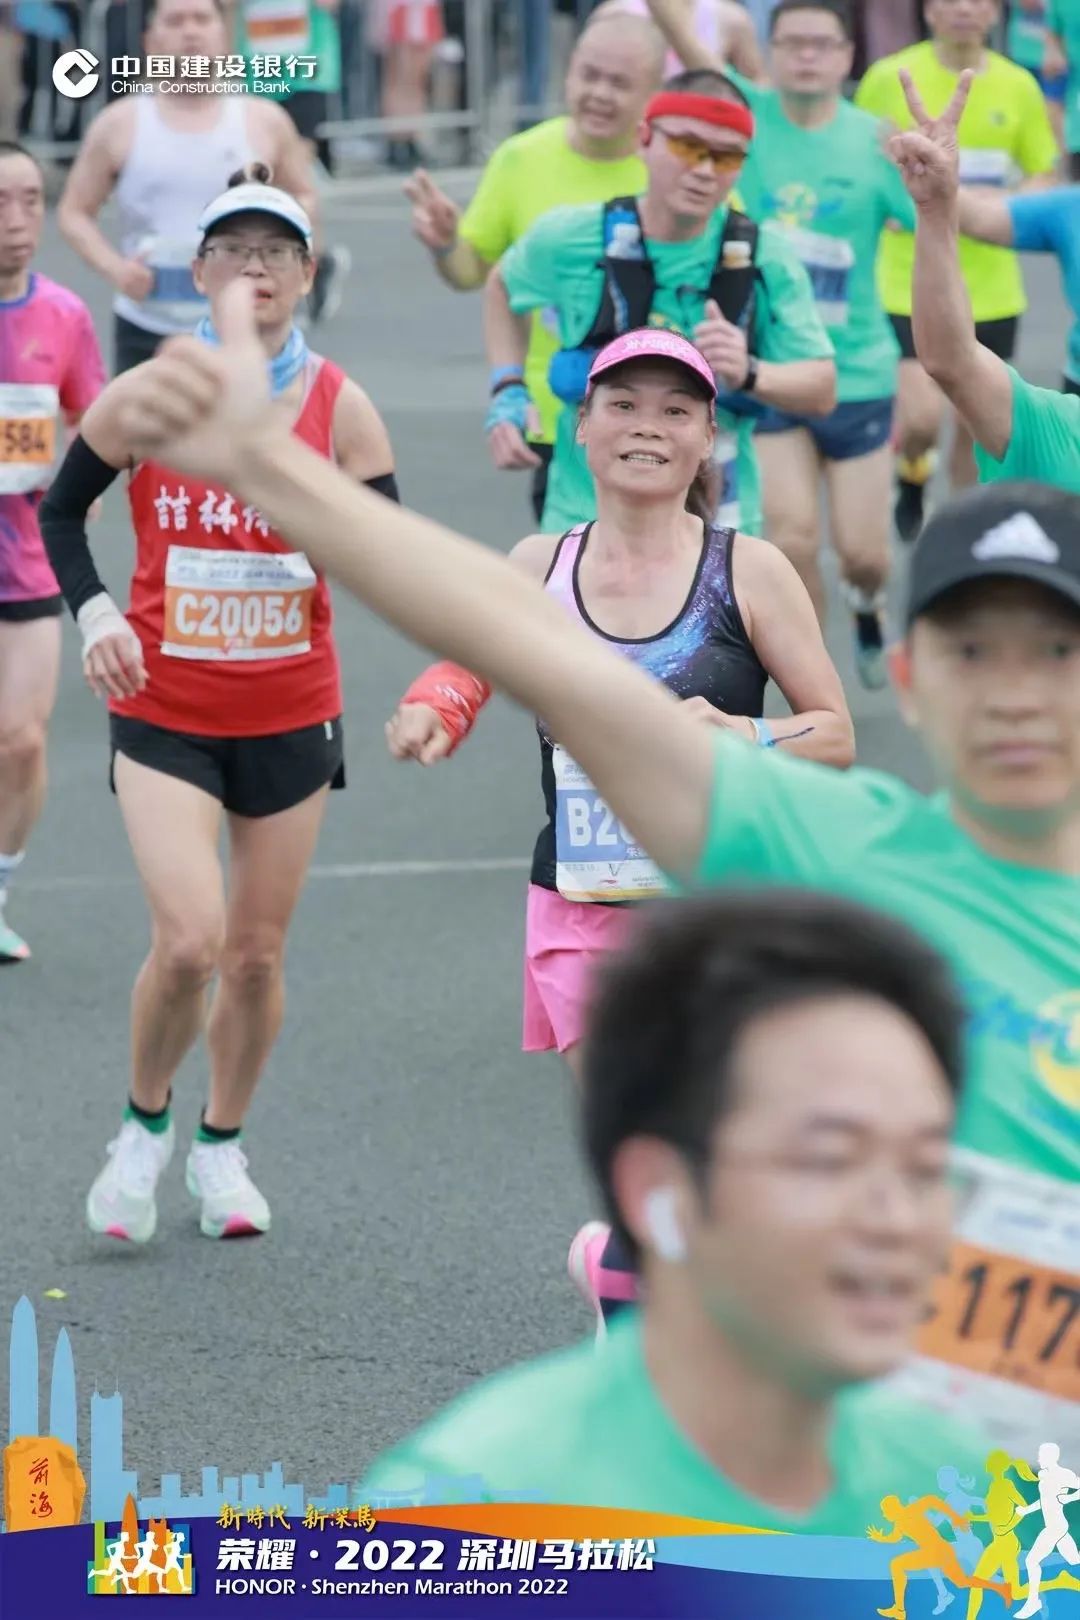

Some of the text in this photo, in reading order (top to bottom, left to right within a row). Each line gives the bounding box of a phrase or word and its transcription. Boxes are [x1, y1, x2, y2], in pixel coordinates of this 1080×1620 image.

[0, 420, 46, 454] 584
[175, 592, 304, 638] C20056
[920, 1262, 1080, 1362] 117
